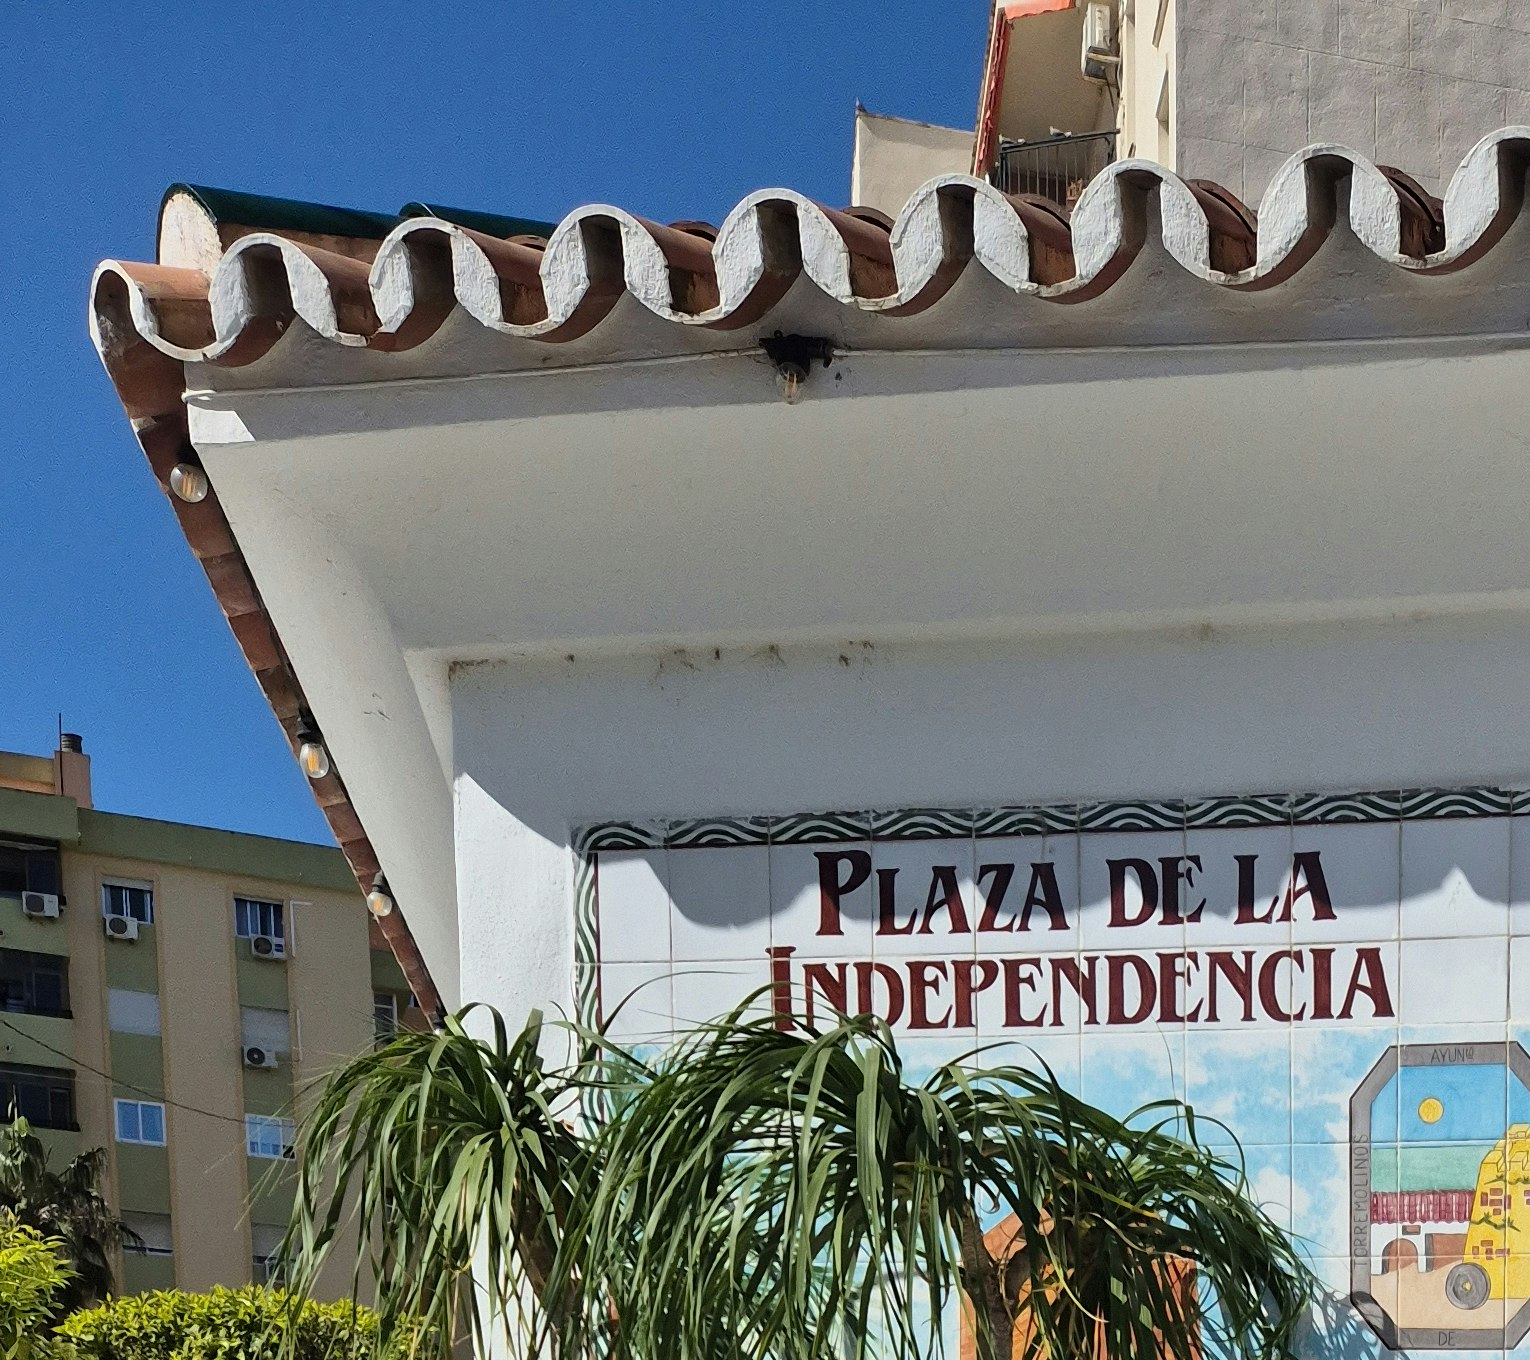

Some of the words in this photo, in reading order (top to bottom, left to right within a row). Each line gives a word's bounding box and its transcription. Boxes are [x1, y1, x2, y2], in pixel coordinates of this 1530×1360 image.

[813, 850, 1071, 936] PLAZA
[1105, 855, 1206, 927] DE
[1233, 851, 1338, 925] LA
[765, 946, 1395, 1031] INDEPENDENCIA
[1353, 1134, 1369, 1269] TORREMOLINOS
[1438, 1331, 1456, 1346] DE
